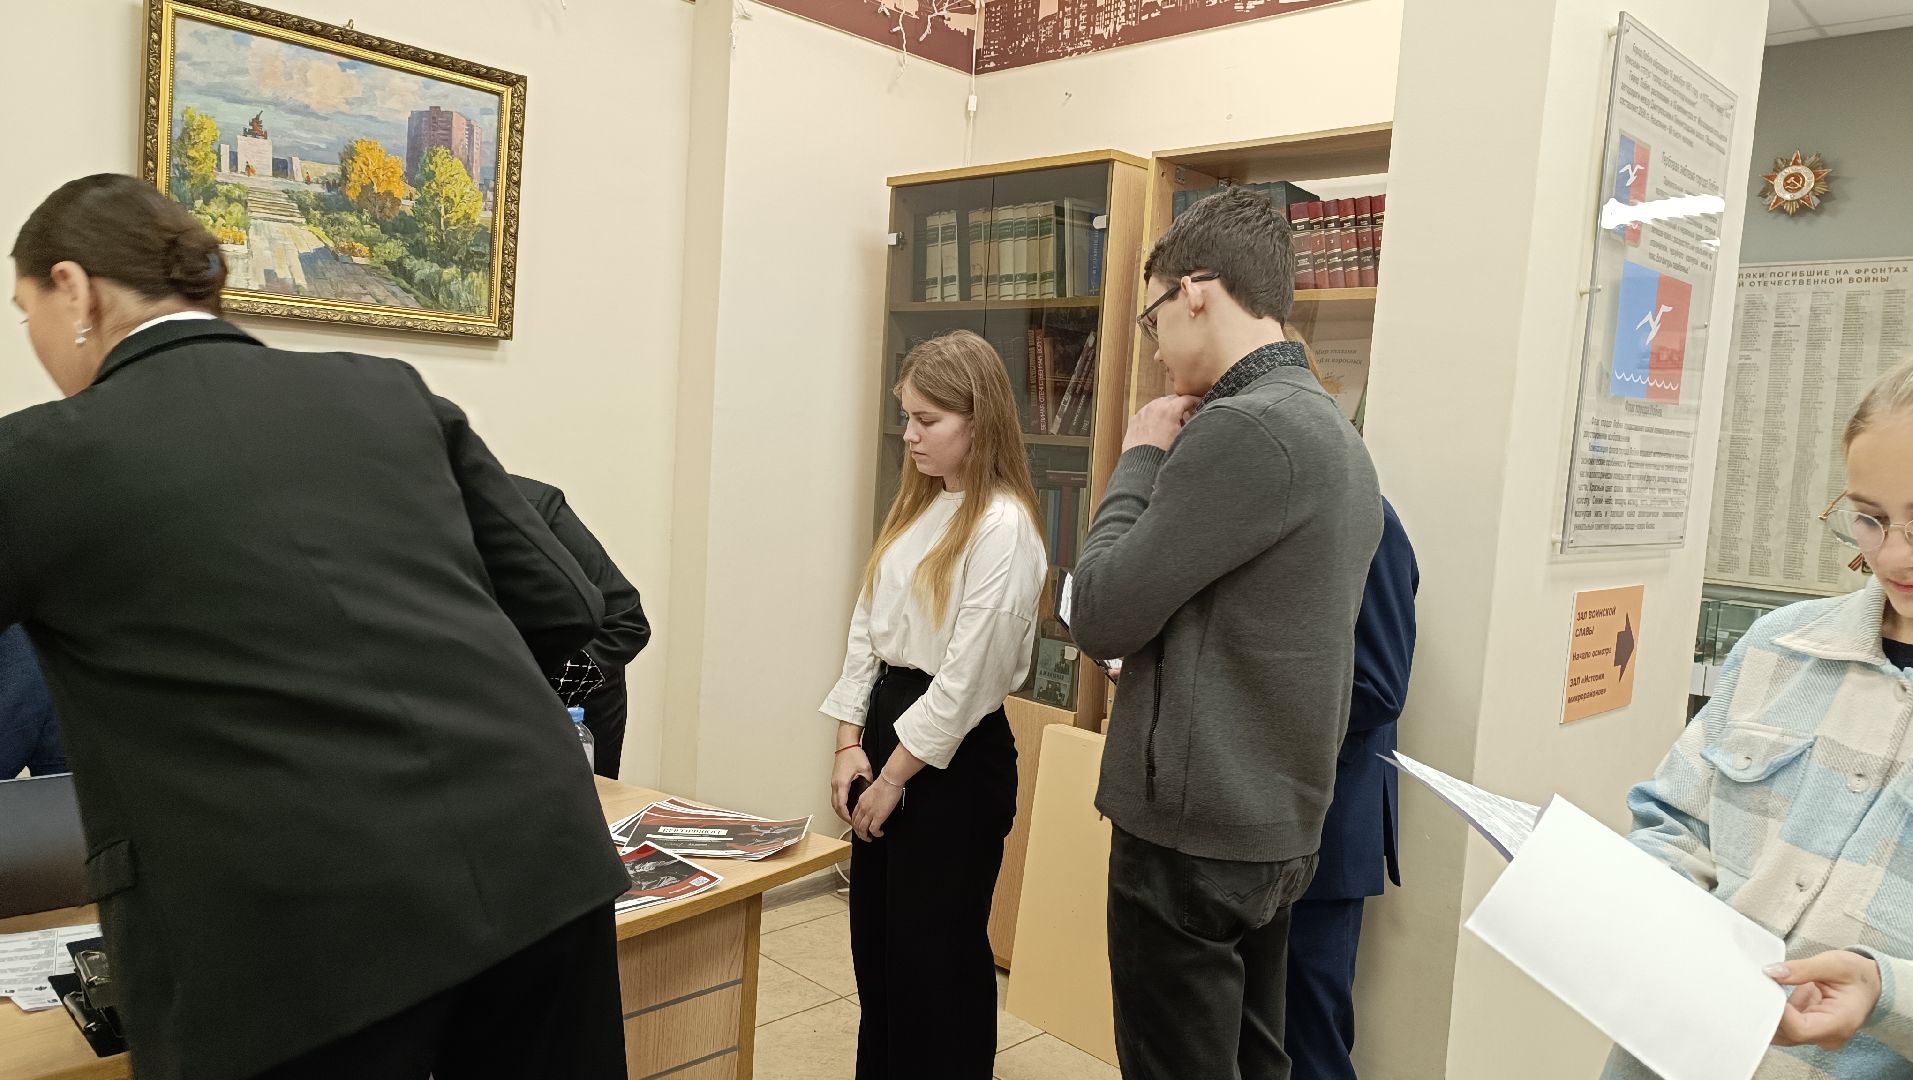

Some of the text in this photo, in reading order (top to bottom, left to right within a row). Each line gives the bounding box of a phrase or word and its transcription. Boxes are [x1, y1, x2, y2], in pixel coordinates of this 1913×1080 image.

[1770, 269, 1830, 278] ПОГИБШИЕ
[1855, 266, 1909, 275] ФРОНТАХ
[1848, 276, 1890, 284] ВОЙНЫ
[1575, 625, 1595, 637] СЛАВЫ
[1572, 647, 1612, 661] Начало осмотра
